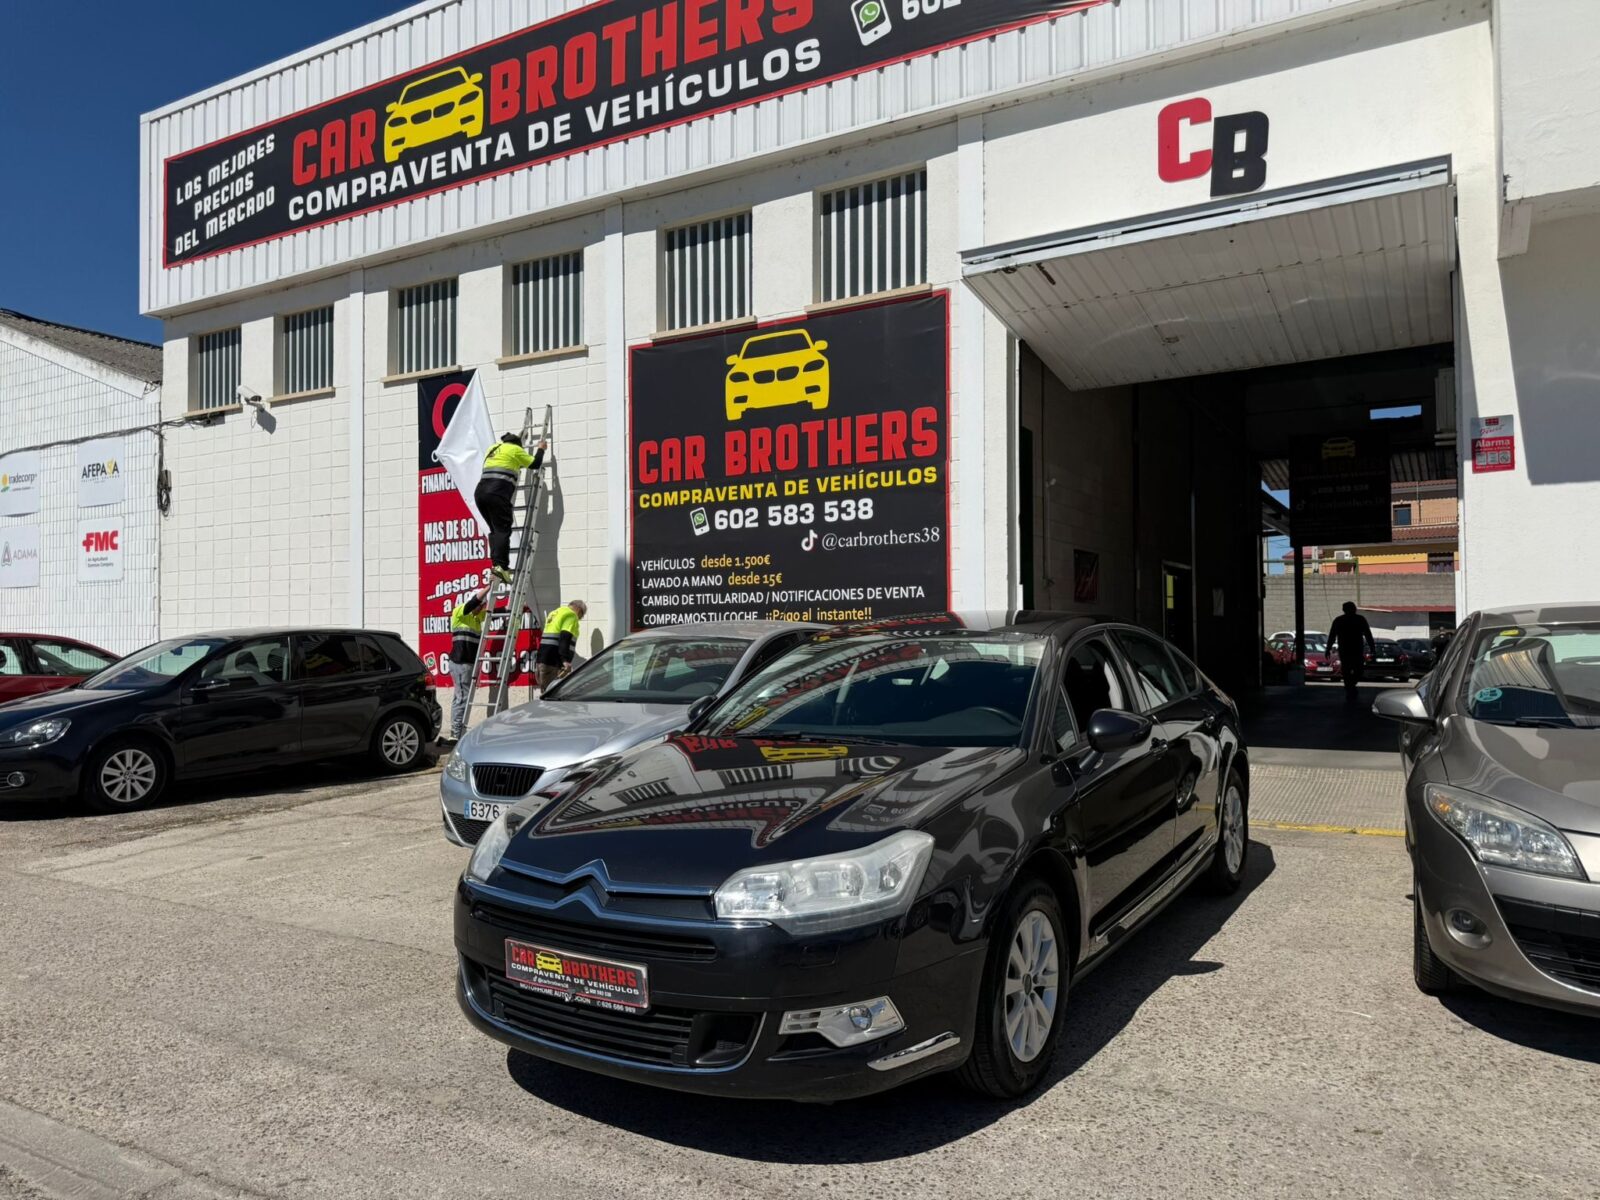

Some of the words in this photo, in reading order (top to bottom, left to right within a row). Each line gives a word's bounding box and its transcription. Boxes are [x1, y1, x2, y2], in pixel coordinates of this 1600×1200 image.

[288, 132, 516, 221] COMPRAVENTA
[528, 112, 572, 152] DE
[585, 38, 821, 133] VEHÍCULOS
[292, 108, 377, 187] CAR
[1158, 97, 1269, 197] CB
[176, 175, 201, 206] LOS
[208, 133, 275, 188] MEJORES
[194, 171, 254, 221] PRECIOS
[175, 228, 200, 256] DEL
[206, 185, 275, 240] MERCADO
[638, 435, 706, 485] CAR
[725, 406, 938, 477] BROTHERS
[1475, 438, 1511, 449] Alarma
[638, 479, 778, 509] COMPRAVENTA
[784, 478, 809, 496] DE
[816, 466, 938, 494] VEHÍCULOS
[714, 507, 759, 530] 602
[767, 502, 815, 526] 583
[823, 497, 874, 523] 538
[82, 530, 119, 552] FMC
[424, 521, 444, 543] MAS
[445, 519, 459, 540] DE
[460, 517, 475, 539] 80
[821, 526, 941, 551] @carbrothers38
[13, 548, 38, 560] ADAMA
[425, 538, 485, 564] DISPONIBLES
[641, 557, 696, 571] VEHÍCULOS
[701, 554, 733, 569] desde
[734, 554, 771, 570] 1.500€
[641, 576, 681, 590] LAVADO
[682, 576, 690, 588] A
[691, 574, 723, 587] MANO
[727, 571, 760, 586] desde
[762, 572, 783, 587] 15€
[641, 594, 680, 607] CAMBIO
[681, 594, 695, 606] DE
[696, 591, 764, 605] TITULARIDAD
[772, 587, 864, 603] NOTIFICACIONES
[867, 586, 882, 600] DE
[884, 585, 926, 599] VENTA
[423, 614, 449, 634] LLÉVATE
[643, 612, 707, 625] COMPRAMOS
[708, 612, 721, 621] TU
[802, 607, 812, 621] al
[817, 606, 873, 621] instante!!
[471, 802, 500, 820] 6376
[511, 946, 535, 967] CAR
[562, 960, 637, 988] BROTHERS
[511, 962, 572, 983] COMPRAVENTA
[574, 977, 585, 986] DE
[587, 979, 640, 995] VEHÍCULOS
